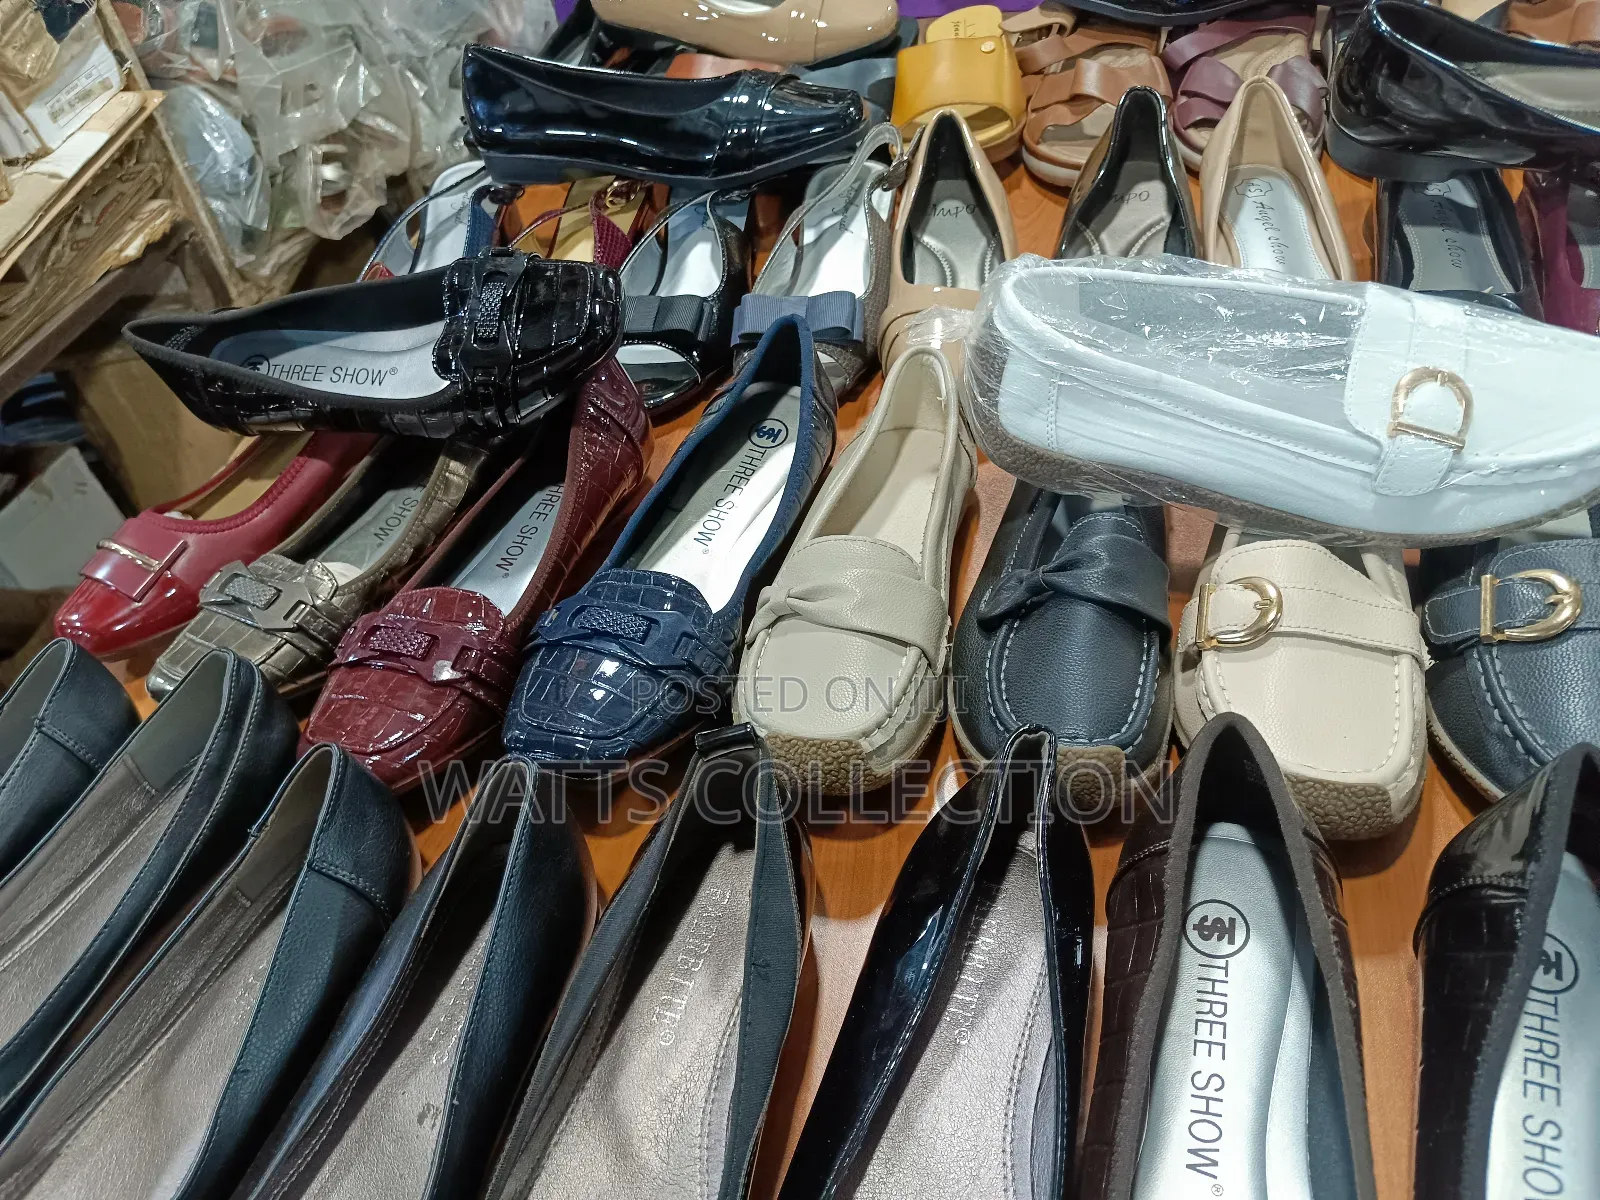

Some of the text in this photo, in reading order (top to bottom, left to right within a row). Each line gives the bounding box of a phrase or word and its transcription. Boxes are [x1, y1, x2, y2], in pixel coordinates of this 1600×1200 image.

[1252, 200, 1282, 232] Angel
[269, 363, 327, 383] THREE
[724, 447, 768, 496] THREE
[528, 484, 565, 522] HREE
[1193, 959, 1229, 1061] THREE
[1523, 996, 1562, 1108] THREE
[1522, 1114, 1565, 1200] SHO
